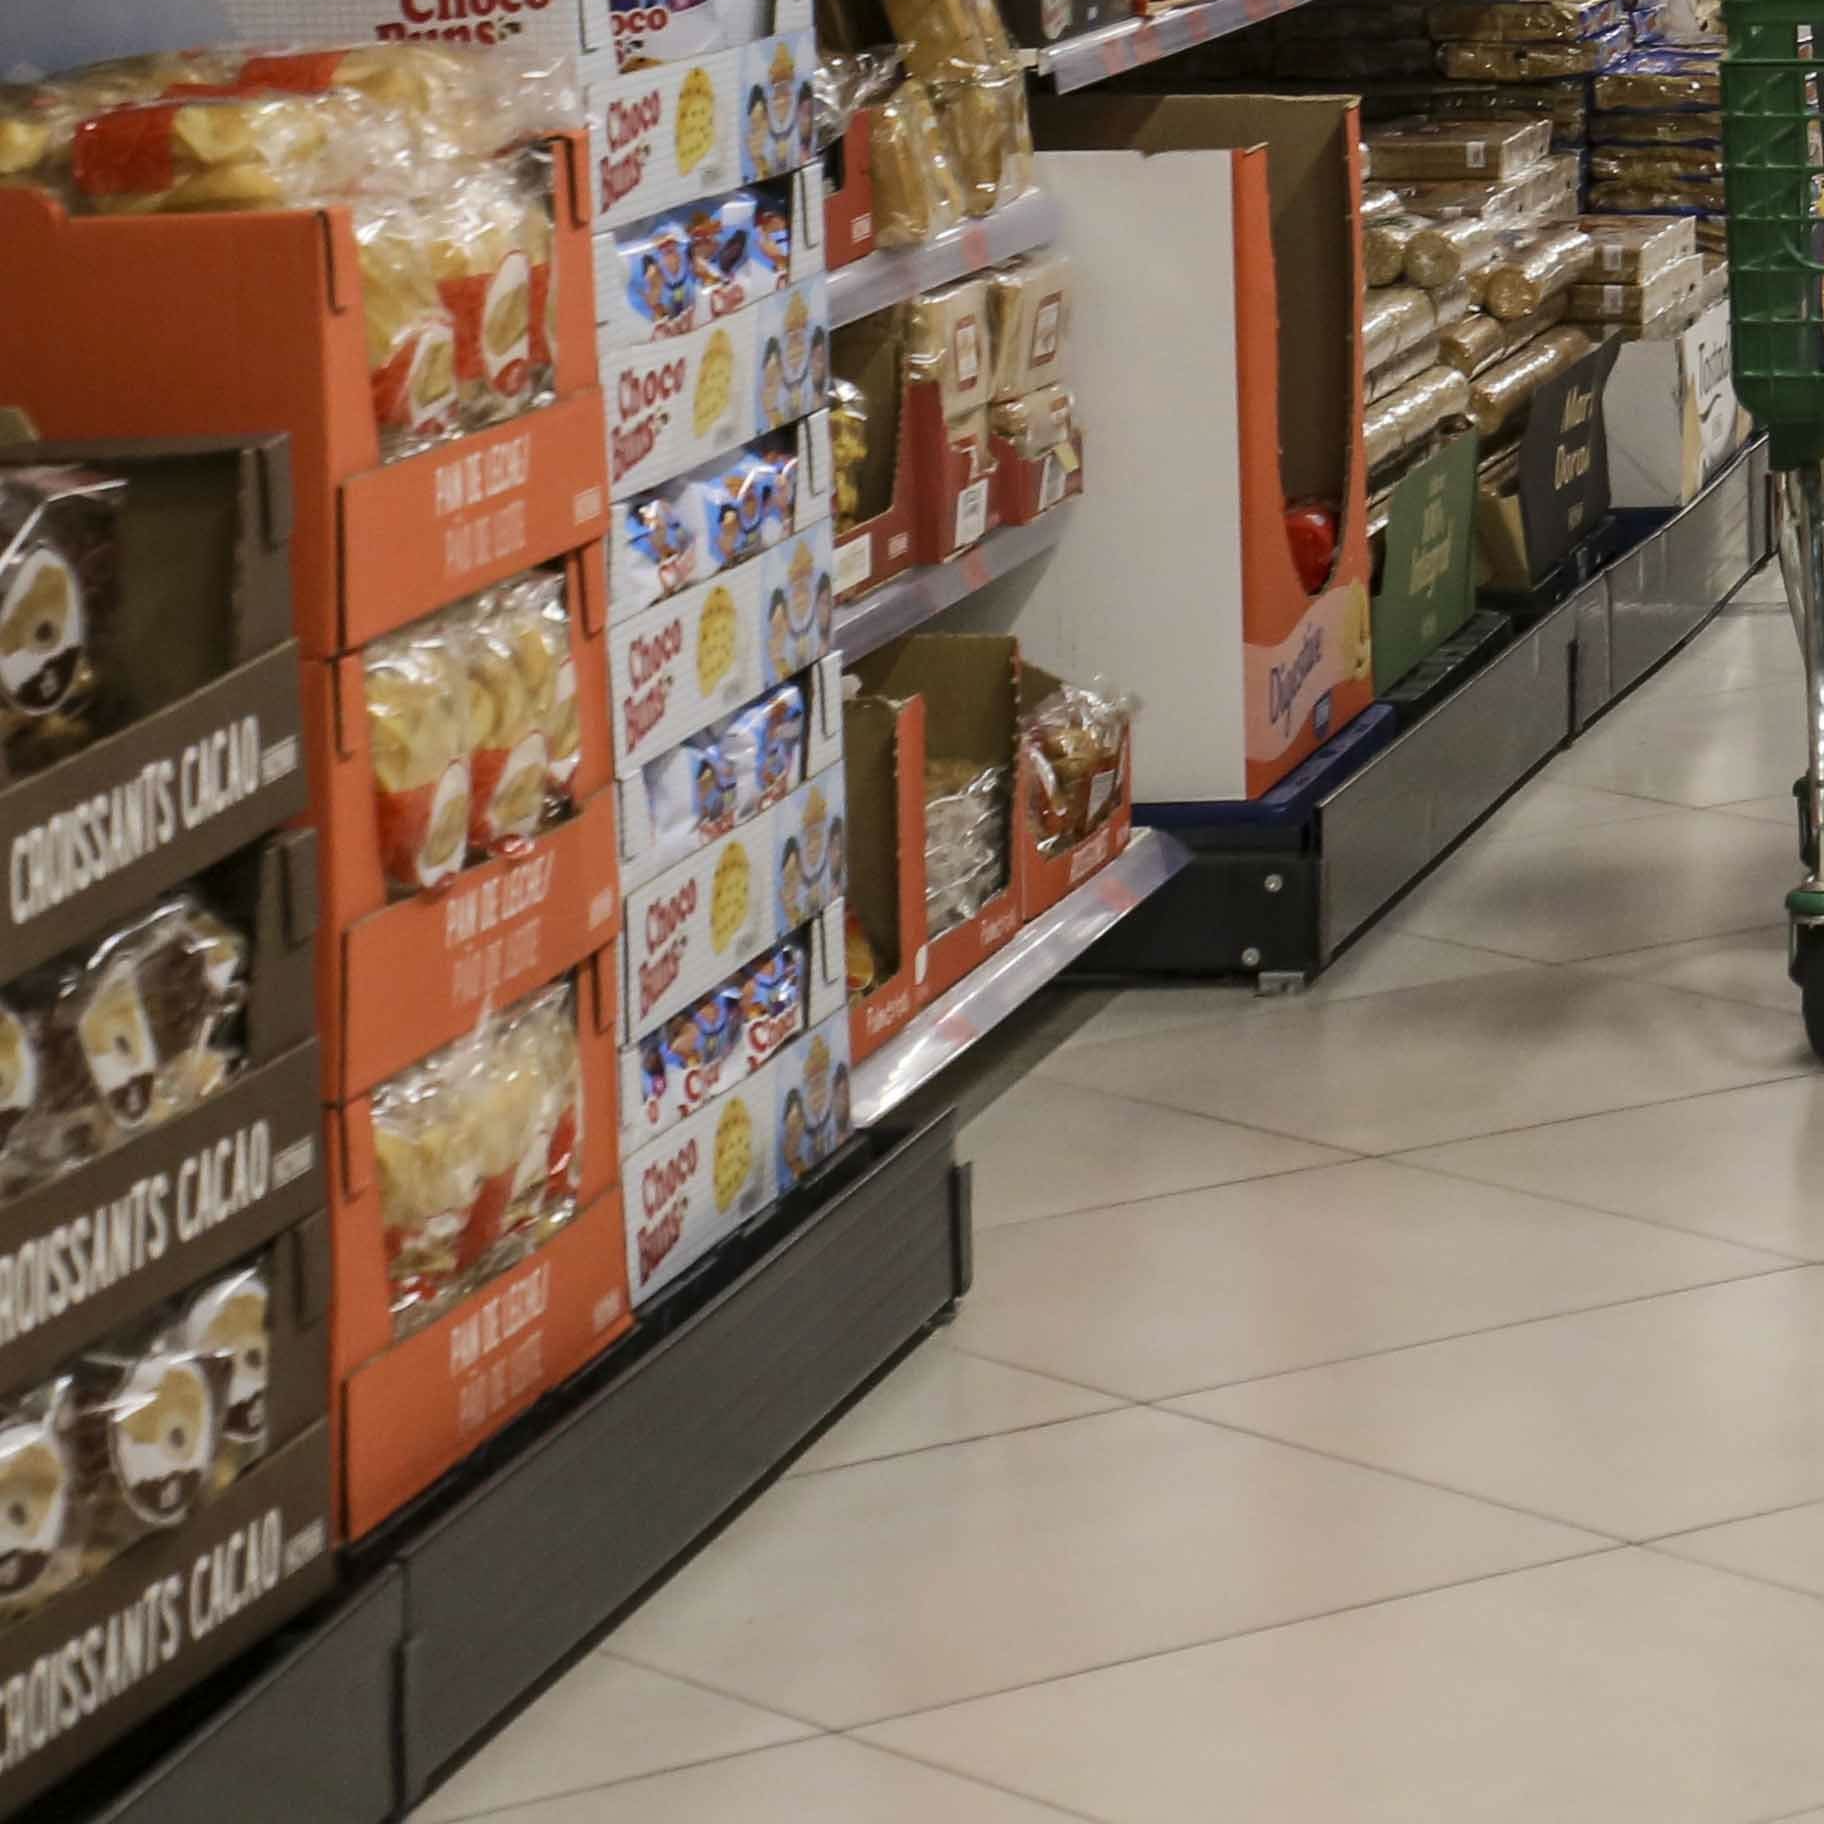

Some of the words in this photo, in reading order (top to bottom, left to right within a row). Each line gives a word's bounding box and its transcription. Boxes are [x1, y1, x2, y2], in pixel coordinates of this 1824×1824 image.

[607, 89, 661, 153] Choco
[617, 356, 688, 424] Choco
[628, 617, 683, 692] Choco
[10, 758, 175, 925] CROISSANTS
[181, 714, 259, 831] CACAO
[645, 877, 697, 956] Choco
[641, 1138, 699, 1220] Choco
[0, 1172, 169, 1348] ROISSANTS
[177, 1120, 270, 1244] CACAO
[189, 1508, 284, 1641] CACAO
